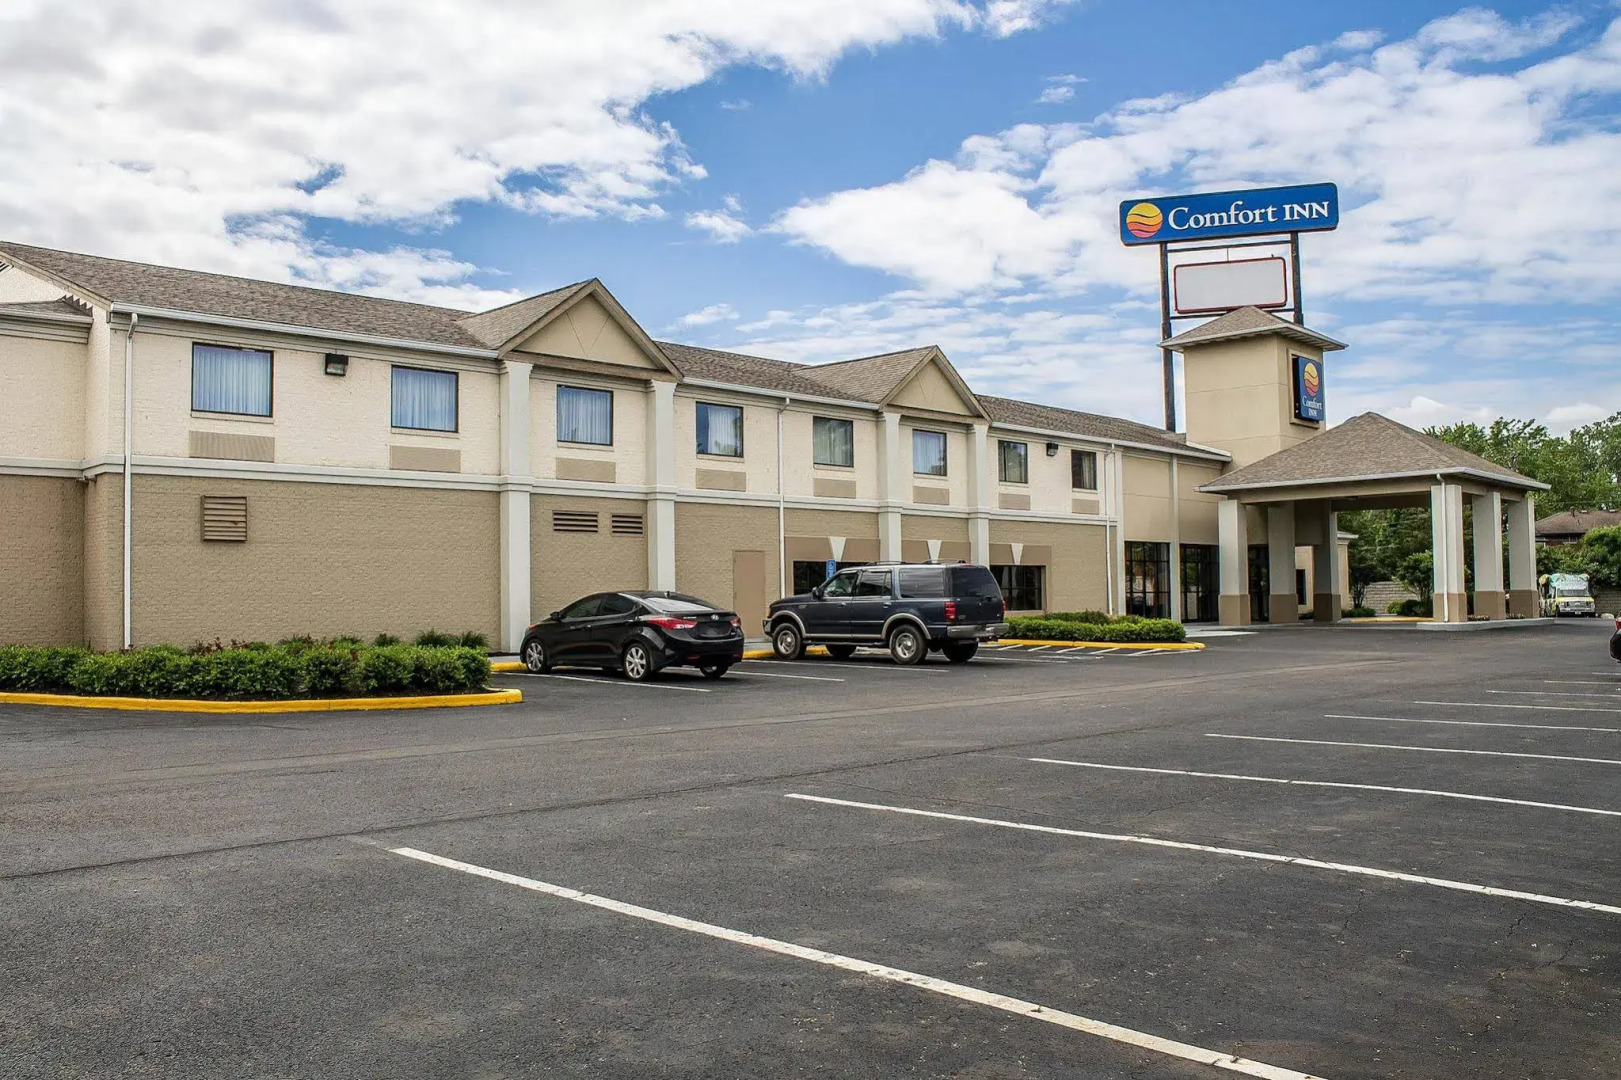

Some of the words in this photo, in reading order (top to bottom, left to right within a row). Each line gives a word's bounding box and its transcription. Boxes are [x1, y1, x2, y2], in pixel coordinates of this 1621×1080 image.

[1168, 200, 1278, 231] Comfort
[1283, 201, 1329, 221] INN
[1302, 395, 1322, 410] Comfort
